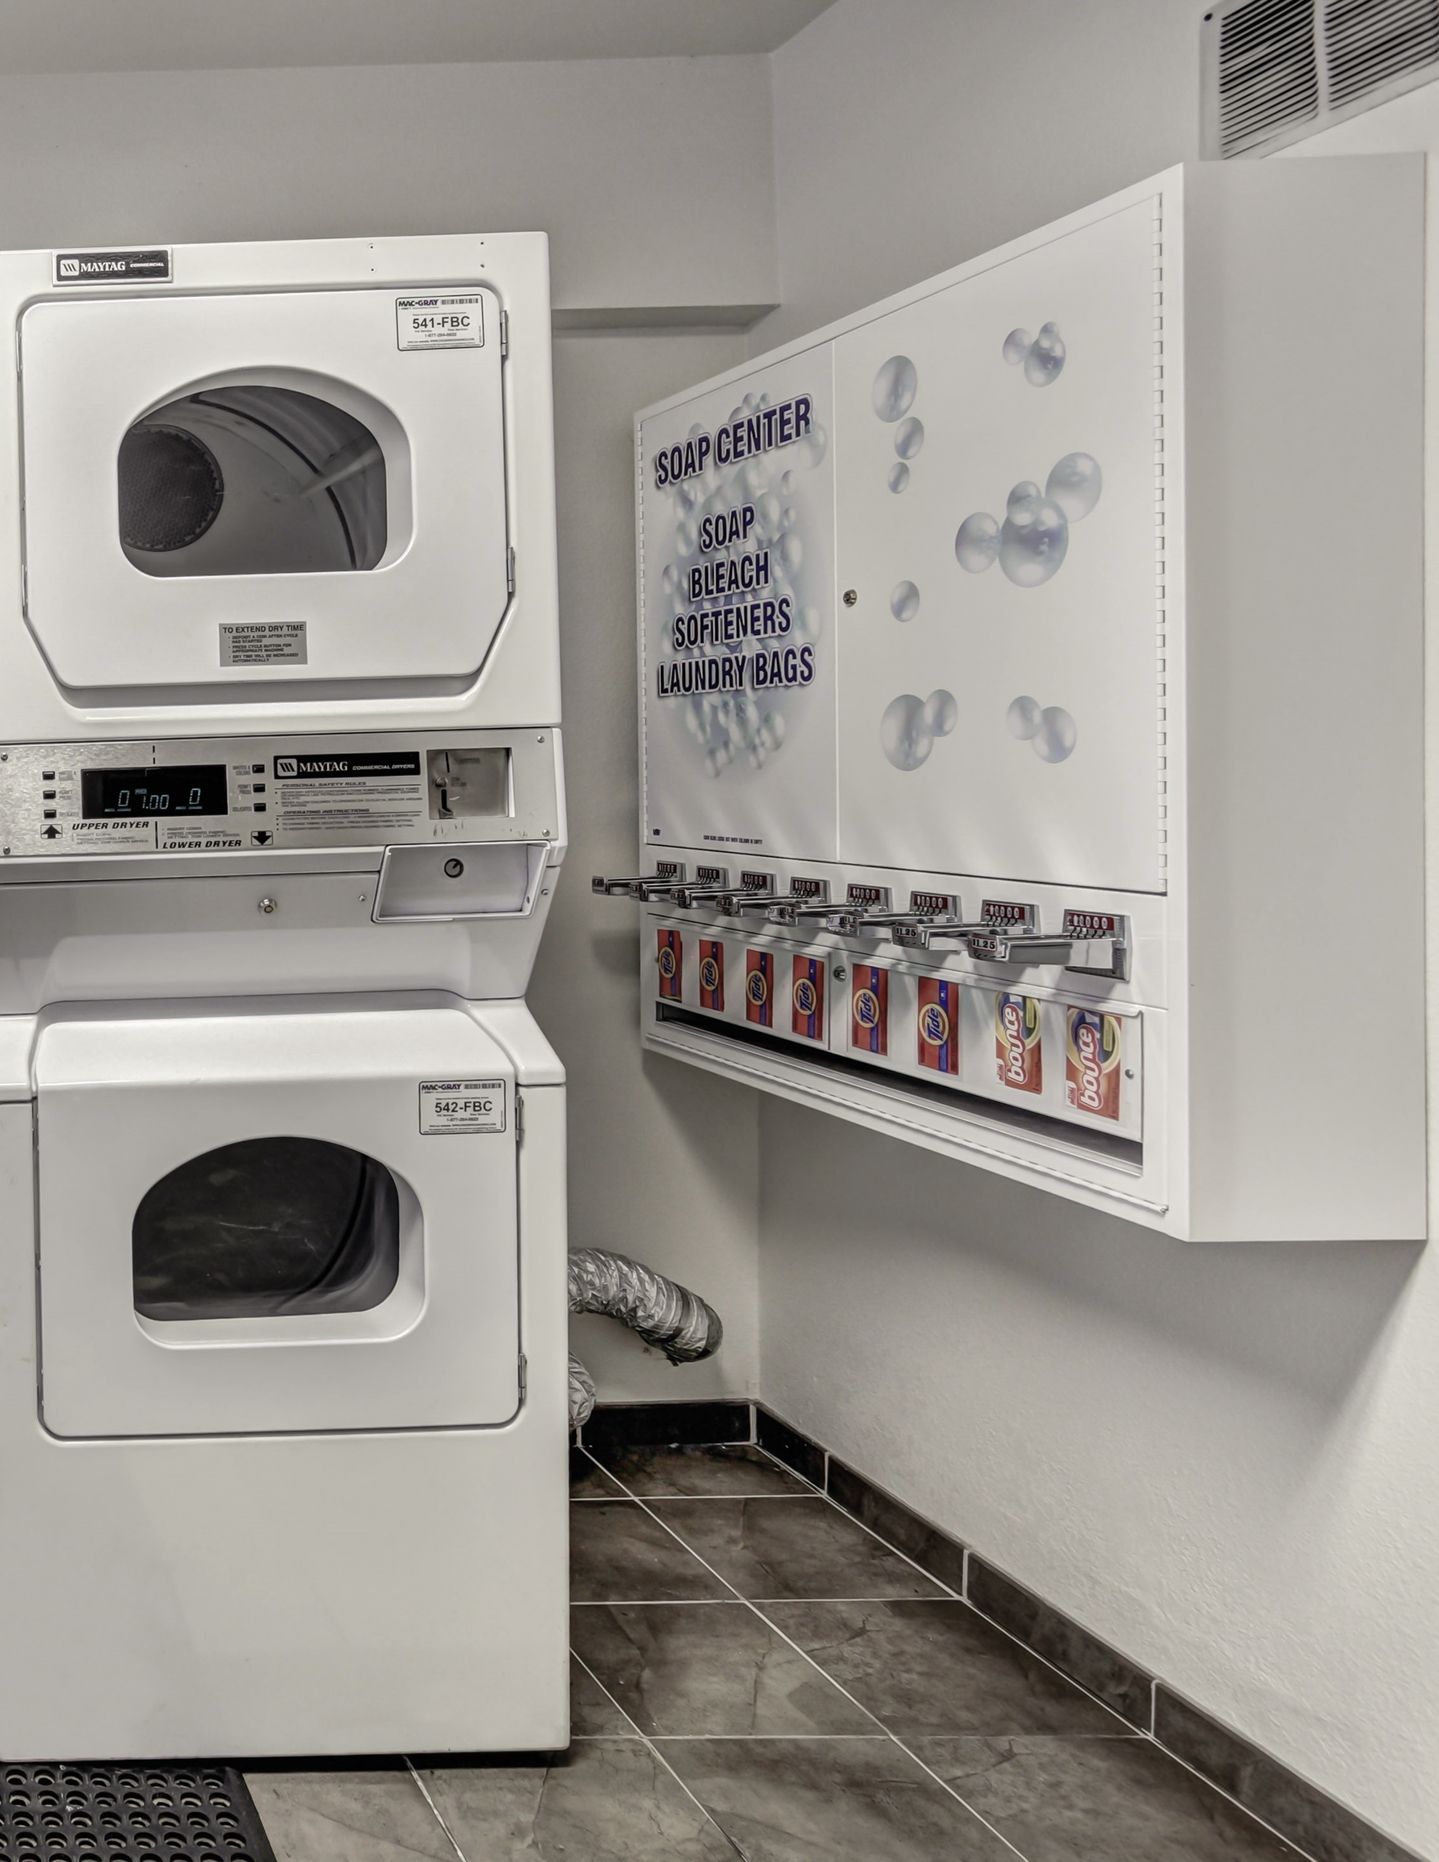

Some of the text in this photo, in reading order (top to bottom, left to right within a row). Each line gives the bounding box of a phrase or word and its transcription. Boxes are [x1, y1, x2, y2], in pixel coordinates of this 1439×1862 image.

[80, 261, 126, 273] MAYTAG
[412, 315, 471, 330] 541-FBC
[656, 396, 814, 486] SOAP CENTER
[701, 504, 756, 552] SOAP
[690, 550, 770, 600] BLEACH
[222, 623, 305, 634] TO EXTEND DRY TIME
[674, 597, 792, 650] SOFTENERS
[659, 645, 815, 697] LAUNDRY BAGS
[299, 761, 348, 773] MAYTAG
[142, 794, 170, 810] 1.00
[71, 821, 150, 831] UPPER DRYER
[162, 839, 242, 849] LOWER DRYER
[663, 950, 675, 977] Tide
[702, 961, 717, 985] Tide
[751, 973, 767, 1002] Tide
[799, 982, 815, 1012] Tide
[859, 992, 878, 1026] Tide
[926, 1006, 945, 1041] Tide
[1004, 1007, 1025, 1082] bounce
[1078, 1028, 1100, 1109] bounce
[434, 1100, 493, 1114] 542-FBC
